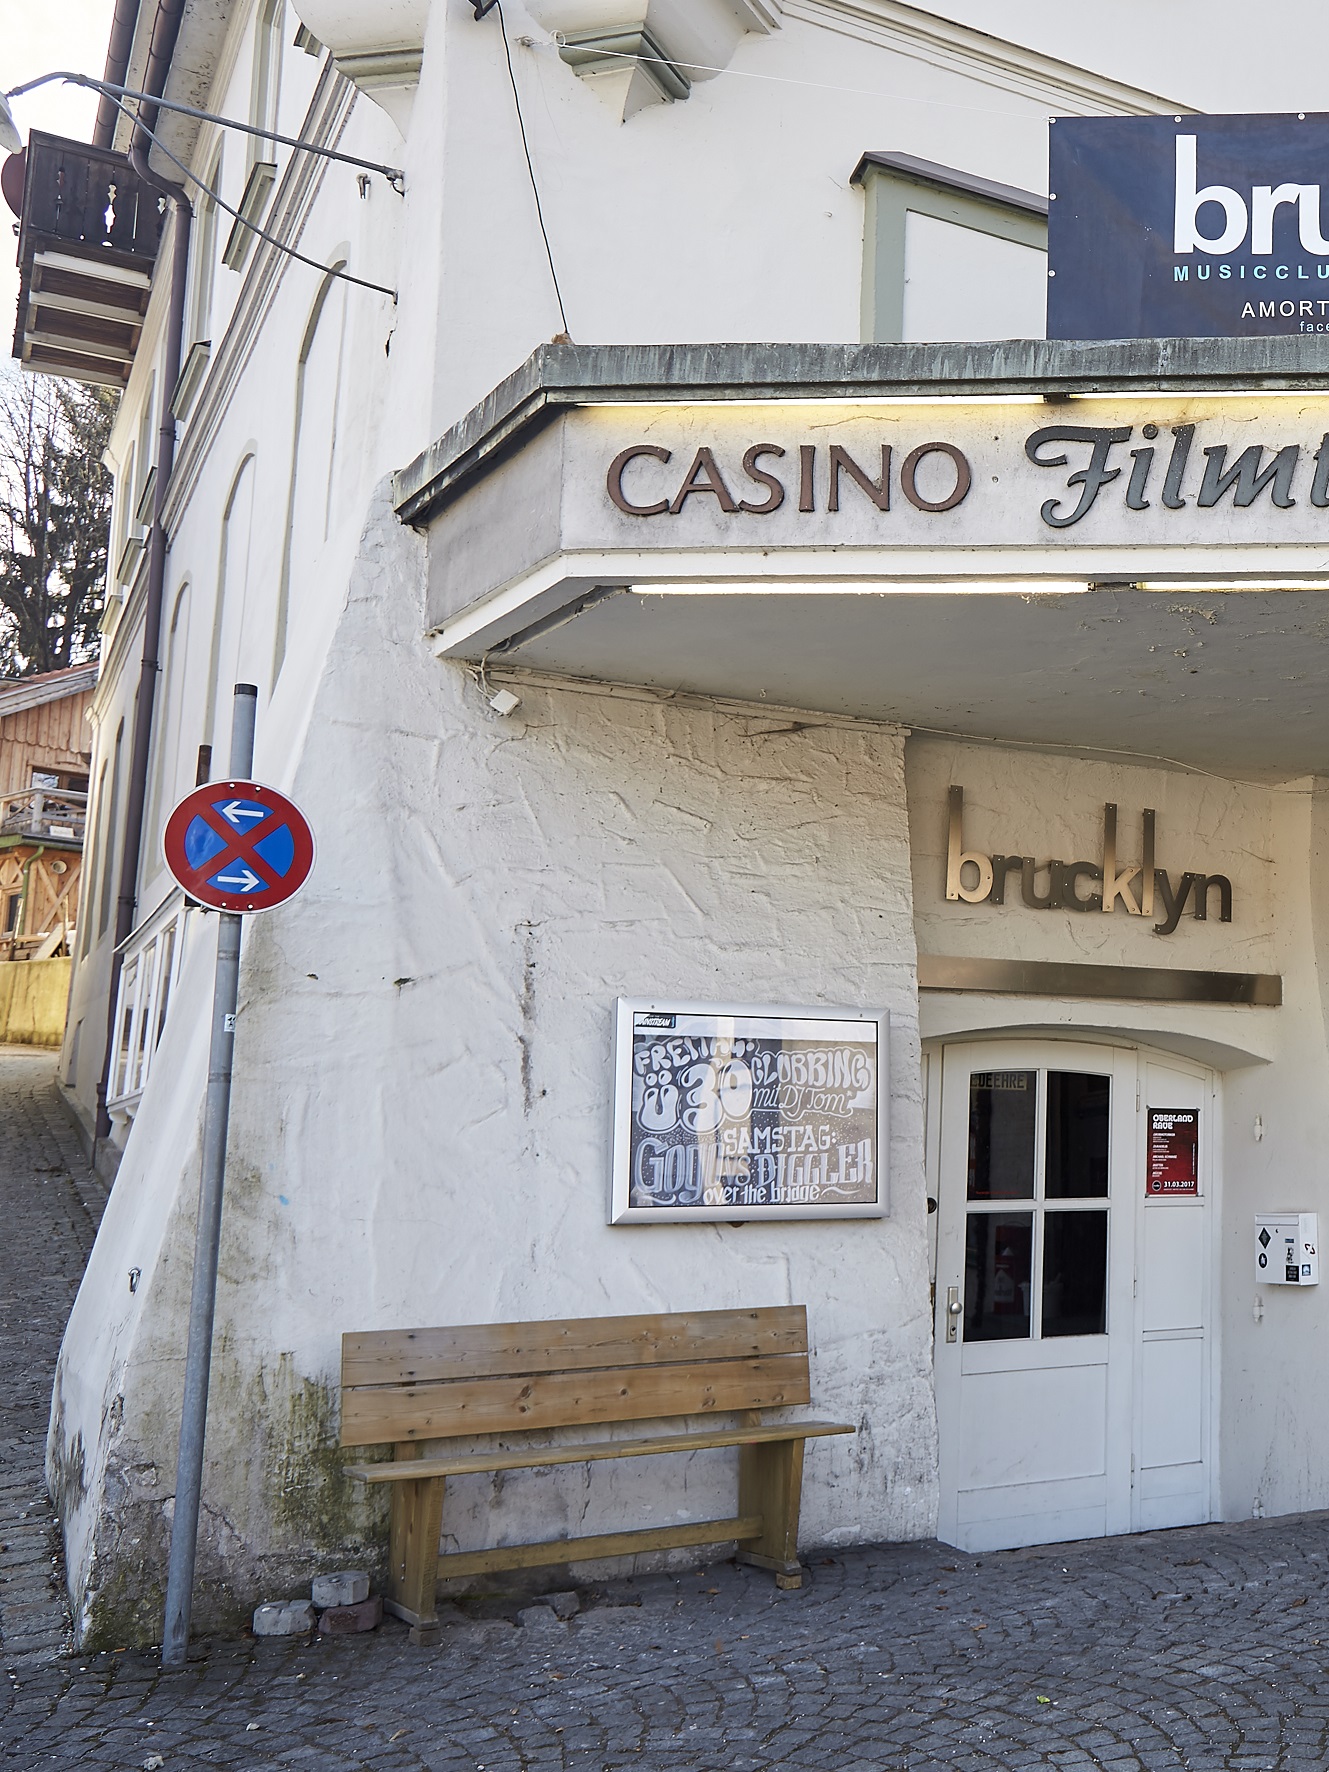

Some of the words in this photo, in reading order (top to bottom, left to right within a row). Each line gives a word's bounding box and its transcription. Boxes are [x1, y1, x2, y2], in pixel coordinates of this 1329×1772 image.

[606, 443, 972, 515] CASINO
[946, 784, 1233, 935] brucklyn
[634, 1035, 756, 1075] FREITAG:
[751, 1049, 872, 1091] CLUBBING
[753, 1084, 783, 1108] mit
[779, 1088, 804, 1116] DJ
[1152, 1114, 1194, 1123] OBERLAND
[723, 1125, 838, 1154] SAMSTAG:
[752, 1138, 873, 1188] DIGGLER
[702, 1185, 740, 1206] over
[741, 1184, 767, 1205] the
[769, 1180, 821, 1204] bridge
